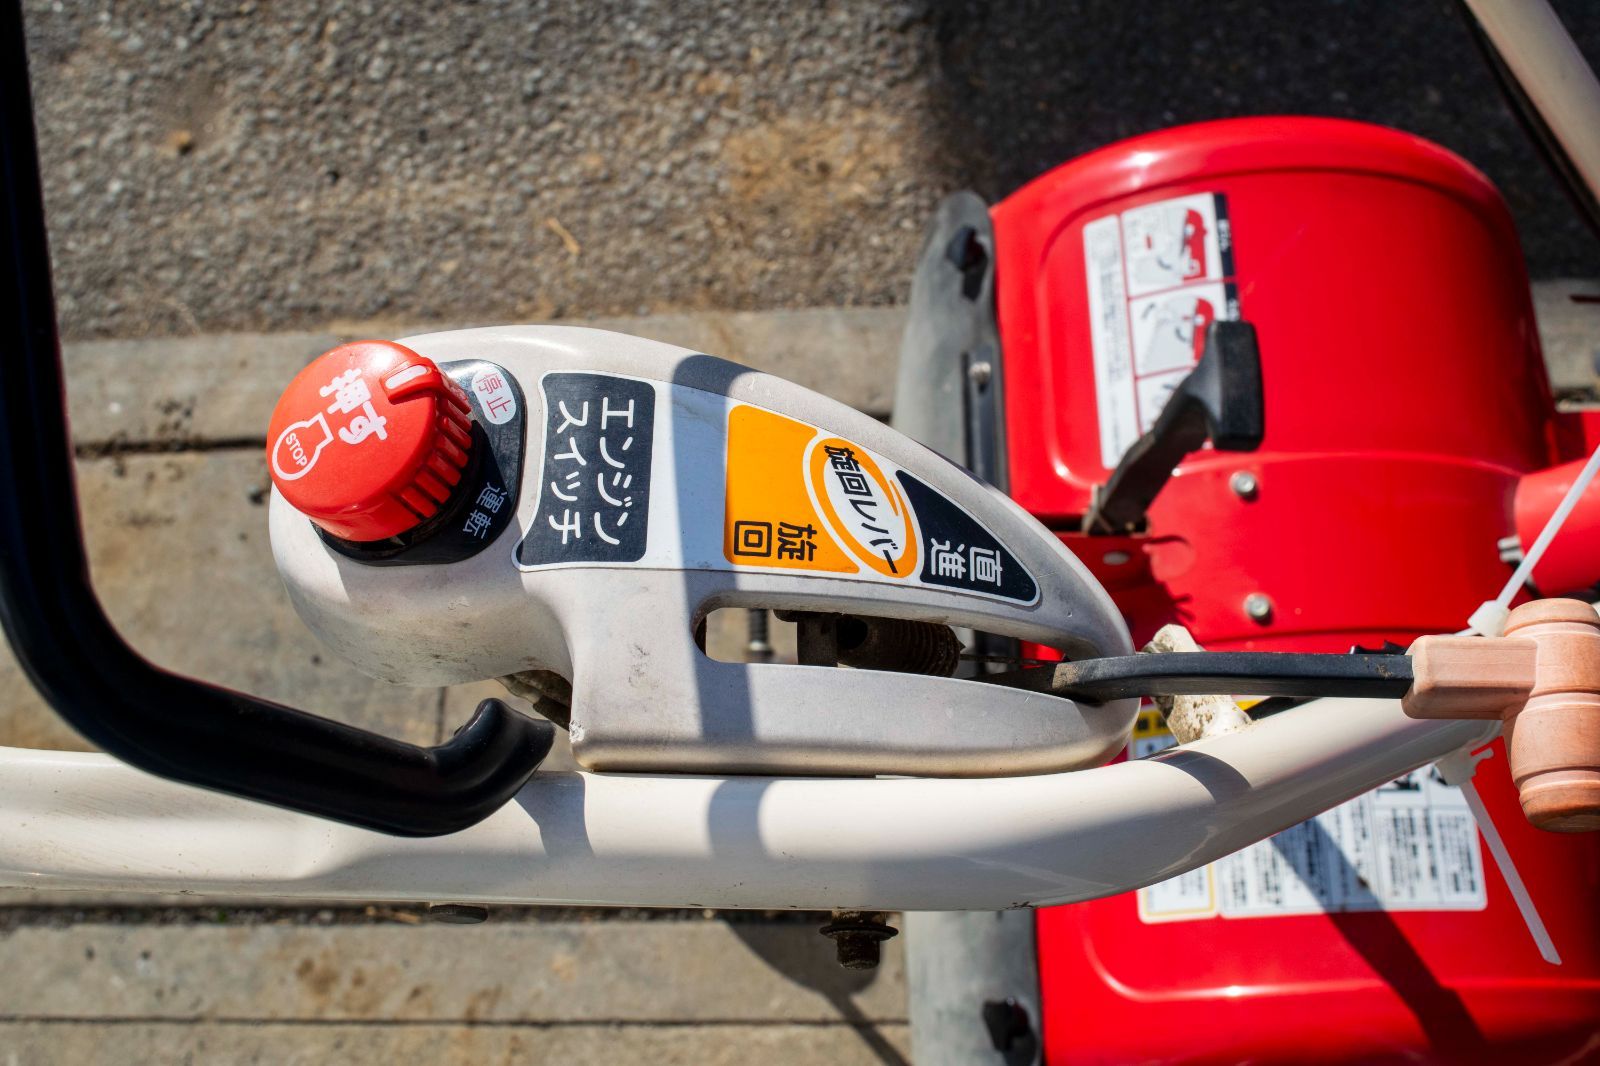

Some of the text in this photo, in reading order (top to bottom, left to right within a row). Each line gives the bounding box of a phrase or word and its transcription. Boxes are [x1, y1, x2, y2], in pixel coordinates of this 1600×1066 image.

[319, 368, 388, 445] 押す
[477, 373, 507, 419] 停止
[286, 432, 308, 467] STOP
[548, 401, 588, 544] スイッチ
[594, 397, 634, 545] エンジン
[463, 482, 508, 538] 運転
[824, 445, 898, 574] 旋回レバー
[734, 520, 817, 562] 旋回
[930, 537, 1003, 587] 直進
